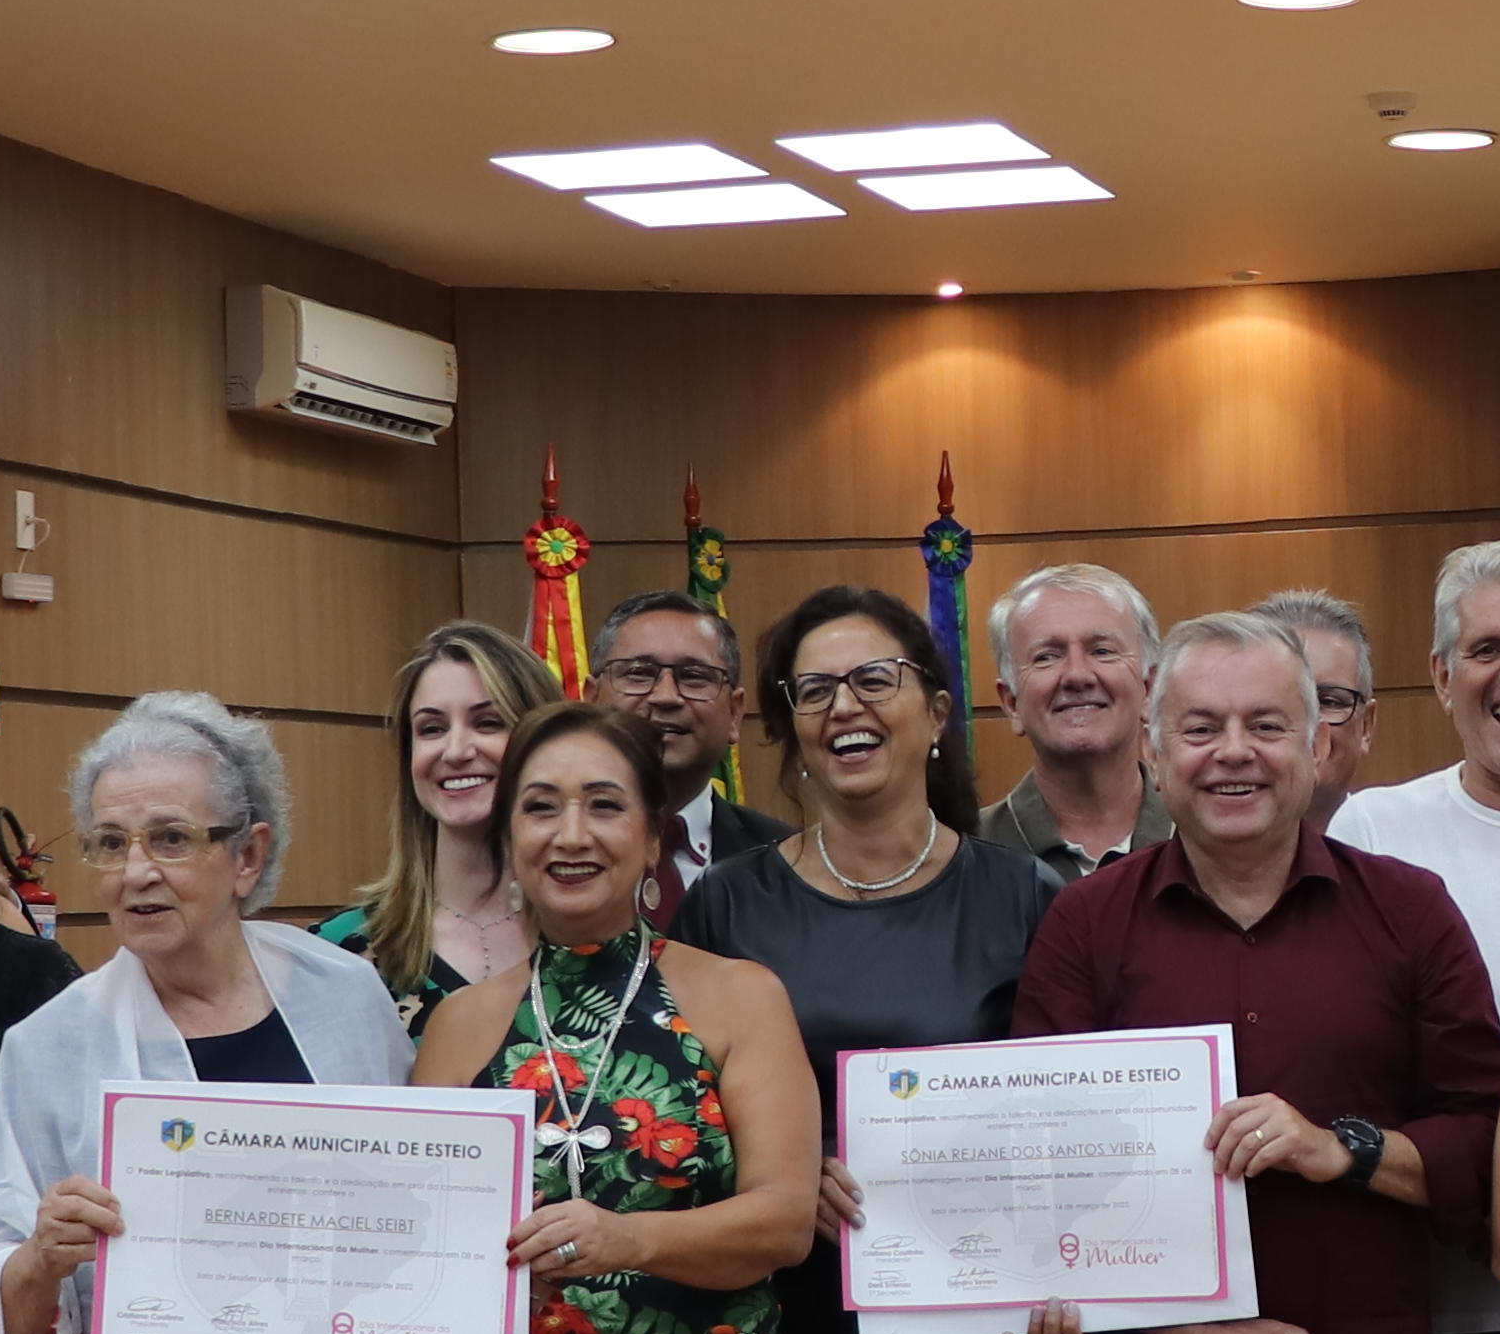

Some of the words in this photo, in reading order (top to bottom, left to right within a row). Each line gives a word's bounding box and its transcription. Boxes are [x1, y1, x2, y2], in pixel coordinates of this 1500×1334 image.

[926, 1071, 1002, 1091] CÂMARA
[1006, 1070, 1098, 1088] MUNICIPAL
[1102, 1069, 1123, 1084] DE
[1128, 1066, 1181, 1083] ESTEIO
[202, 1127, 287, 1149] CÂMARA
[291, 1134, 392, 1155] MUNICIPAL
[396, 1140, 419, 1156] DE
[424, 1141, 482, 1160] ESTEIO
[899, 1146, 947, 1162] SÔNIA
[951, 1146, 1007, 1160] REJANE
[1011, 1144, 1043, 1158] DOS
[1046, 1142, 1104, 1156] SANTOS
[1108, 1140, 1156, 1154] VIEIRA
[204, 1208, 305, 1226] BERNARDETE
[308, 1213, 372, 1230] MACIEL
[376, 1217, 414, 1232] SEIBT
[1085, 1244, 1166, 1268] Mulher
